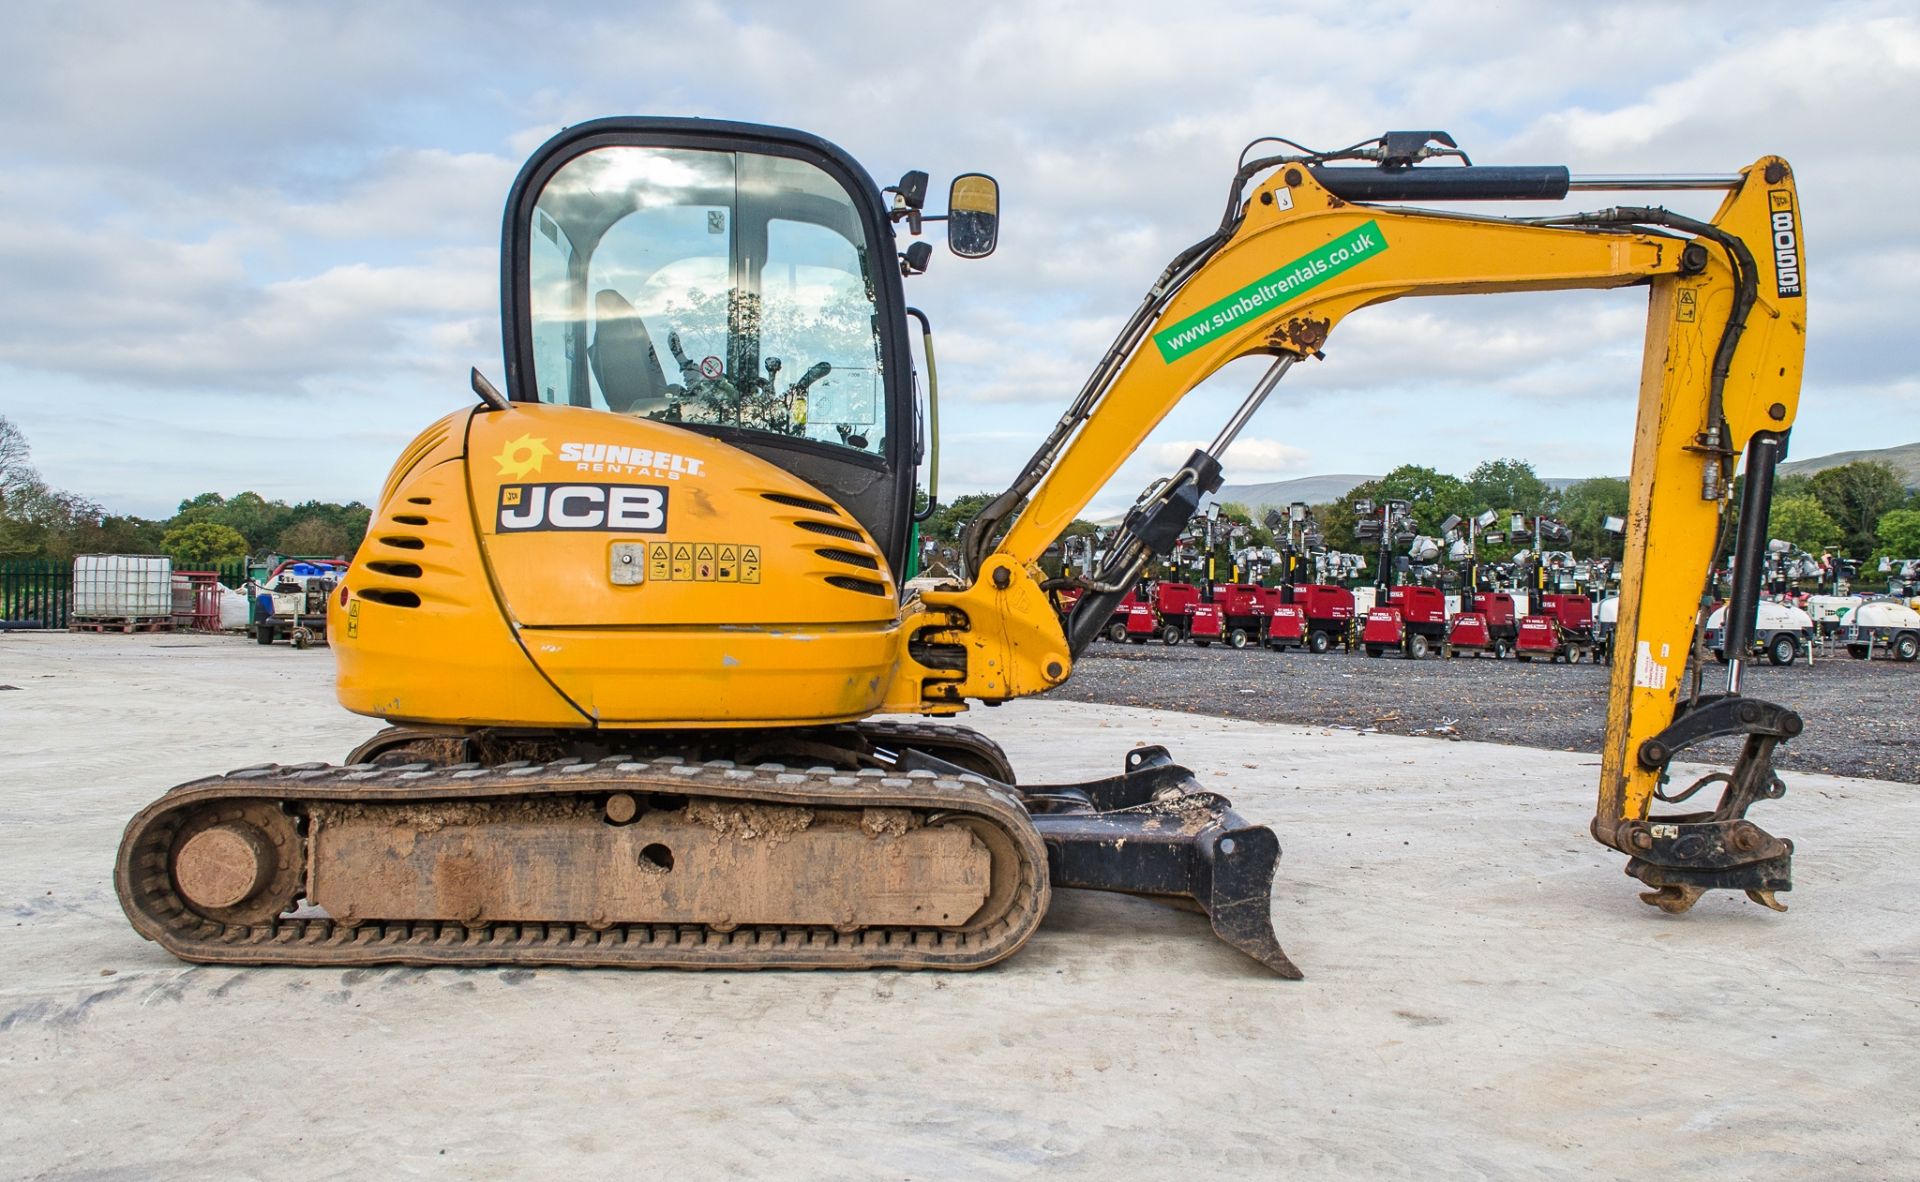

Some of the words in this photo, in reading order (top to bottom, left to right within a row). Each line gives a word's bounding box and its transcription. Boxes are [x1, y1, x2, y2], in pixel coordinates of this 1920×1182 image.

[1772, 212, 1799, 287] 8055
[1167, 232, 1375, 351] www.sunbeltrentals.co.uk
[559, 443, 704, 475] SUNBELT
[576, 462, 681, 480] RENTALS
[501, 486, 664, 529] JCB
